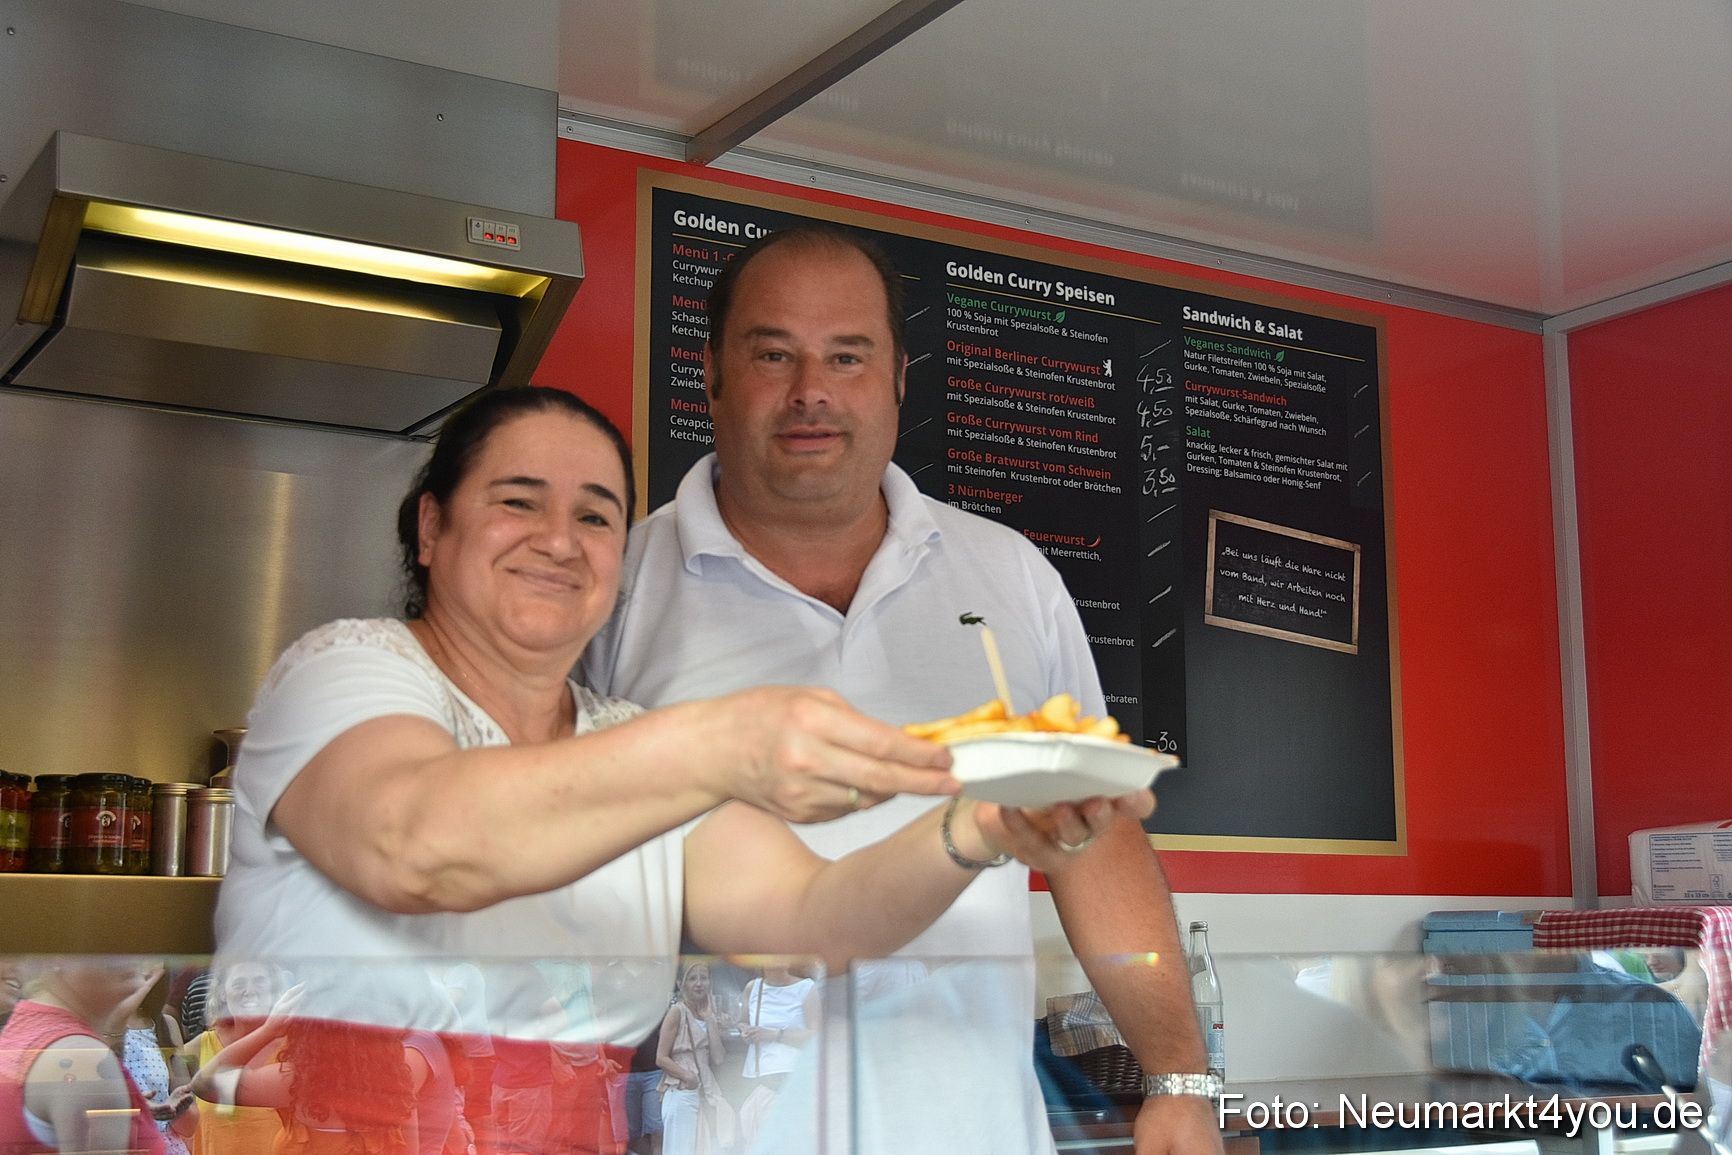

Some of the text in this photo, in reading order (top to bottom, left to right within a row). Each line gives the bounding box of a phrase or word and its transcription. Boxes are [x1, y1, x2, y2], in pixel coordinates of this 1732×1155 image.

[674, 210, 774, 239] Golden Cu
[672, 244, 709, 260] Menü
[713, 251, 718, 261] 1
[672, 272, 714, 290] Ketchup
[946, 261, 1114, 306] Golden Curry Speisen
[946, 292, 1051, 321] Vegane Currywurst
[946, 320, 998, 337] Krustenbrot
[947, 307, 1108, 343] 100 % Soja mit Spezialsoße & Steinofen
[1183, 306, 1303, 341] Sandwich & Salat
[947, 340, 1100, 375] Original Berliner Currywurst
[1183, 335, 1271, 360] Veganes Sandwich
[947, 356, 1115, 391] mit Spezialsoße & Steinofen Krustenbrot
[1184, 349, 1326, 383] Natur Filetstreifen 100 % Soja mit Salat,
[1184, 361, 1326, 393] Gurke, Tomaten, Zwiebeln, Spezialsoße
[670, 398, 706, 413] Menü
[947, 376, 1095, 408] Große Currywurst rot/weiß
[1185, 380, 1287, 406] Currywurst-Sandwich
[947, 392, 1116, 425] mit Spezialsoße & Steinofen Krustenbrot
[1185, 394, 1319, 424] mit Salat, Gurke, Tomaten, Zwiebeln,
[1185, 406, 1326, 436] Spezialsoße, Schärfegrad nach Wunsch
[947, 412, 1098, 443] Große Currywurst vom Rind
[1186, 425, 1211, 438] Salat
[947, 427, 1117, 459] mit Spezialsoße & Steinofen Krustenbrot
[1186, 439, 1348, 471] knackig, lecker & frisch, gemischter Salat mit
[947, 448, 1111, 479] Große Bratwurst vom Schwein
[947, 463, 1121, 494] mit Steinofen Krustenbrot oder Brötchen
[1186, 451, 1342, 482] Gurken, Tomaten & Steinofen Krustenbrot,
[1187, 463, 1321, 489] Dressing: Balsamico oder Honig-Senf
[948, 483, 1023, 505] 3 Nürnberger
[948, 499, 1001, 514] im Brötchen
[1023, 528, 1085, 546] Feuerwurst
[1050, 546, 1102, 562] Meerrettich,
[1242, 553, 1258, 562] uns
[1261, 554, 1282, 568] läuft
[1285, 560, 1300, 571] die
[1302, 564, 1322, 577] Ware
[1325, 570, 1346, 582] nicht
[1220, 569, 1346, 603] vom Band, wir Arbeiten noch
[1238, 594, 1254, 604] mit
[1257, 597, 1276, 608] Herz
[1279, 602, 1296, 613] und
